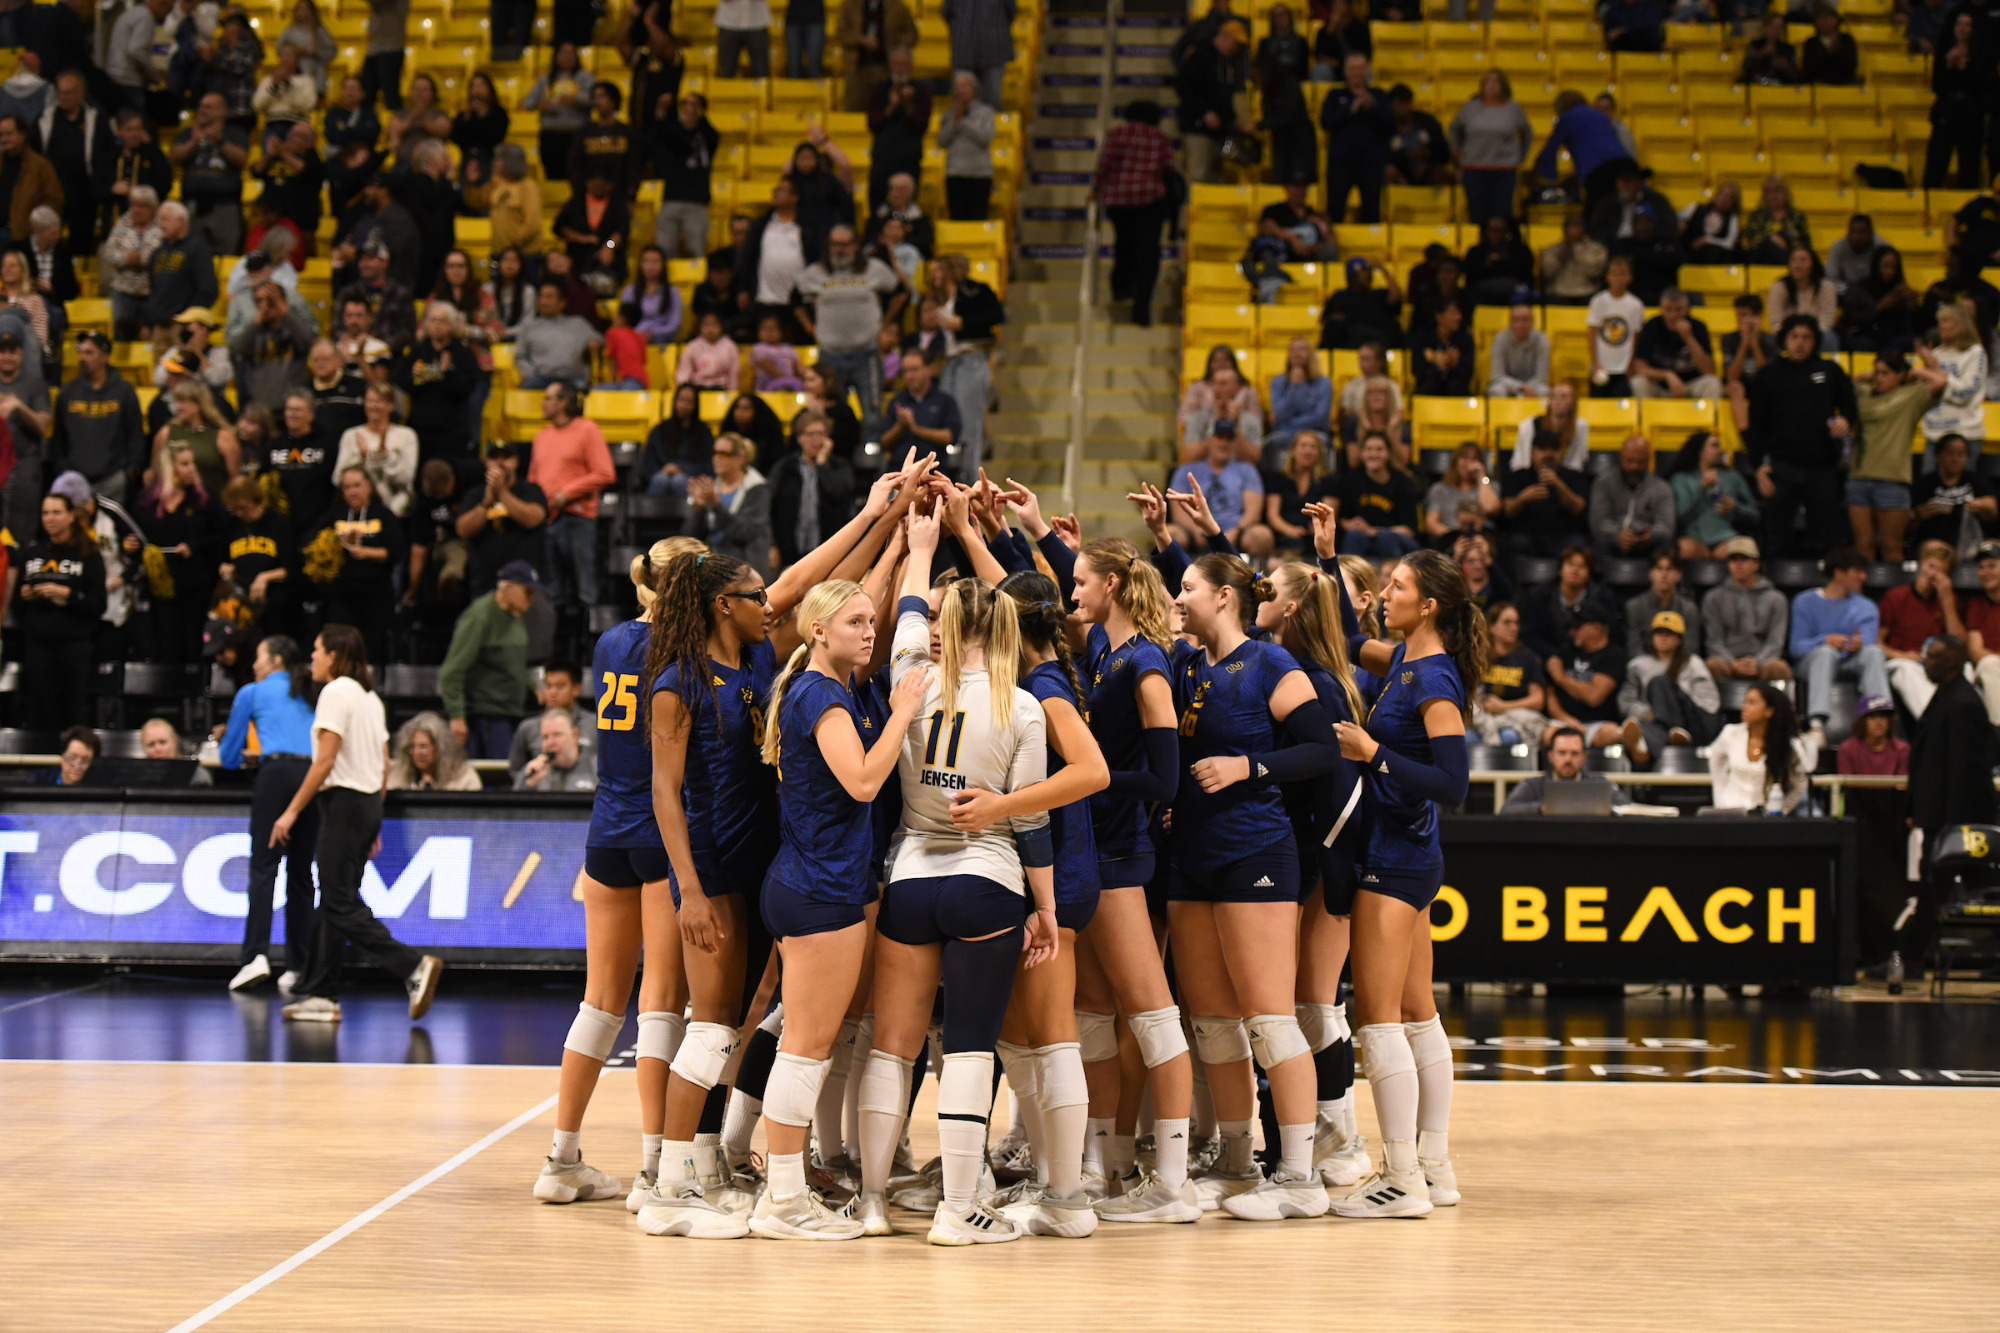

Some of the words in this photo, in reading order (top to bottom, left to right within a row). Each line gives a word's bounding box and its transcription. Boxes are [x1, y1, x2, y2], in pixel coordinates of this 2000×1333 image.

[270, 447, 324, 464] BEACH
[229, 537, 277, 558] BEACH
[597, 671, 638, 731] 25
[924, 707, 968, 770] 11
[920, 769, 967, 790] JENSEN
[1502, 885, 1816, 943] BEACH
